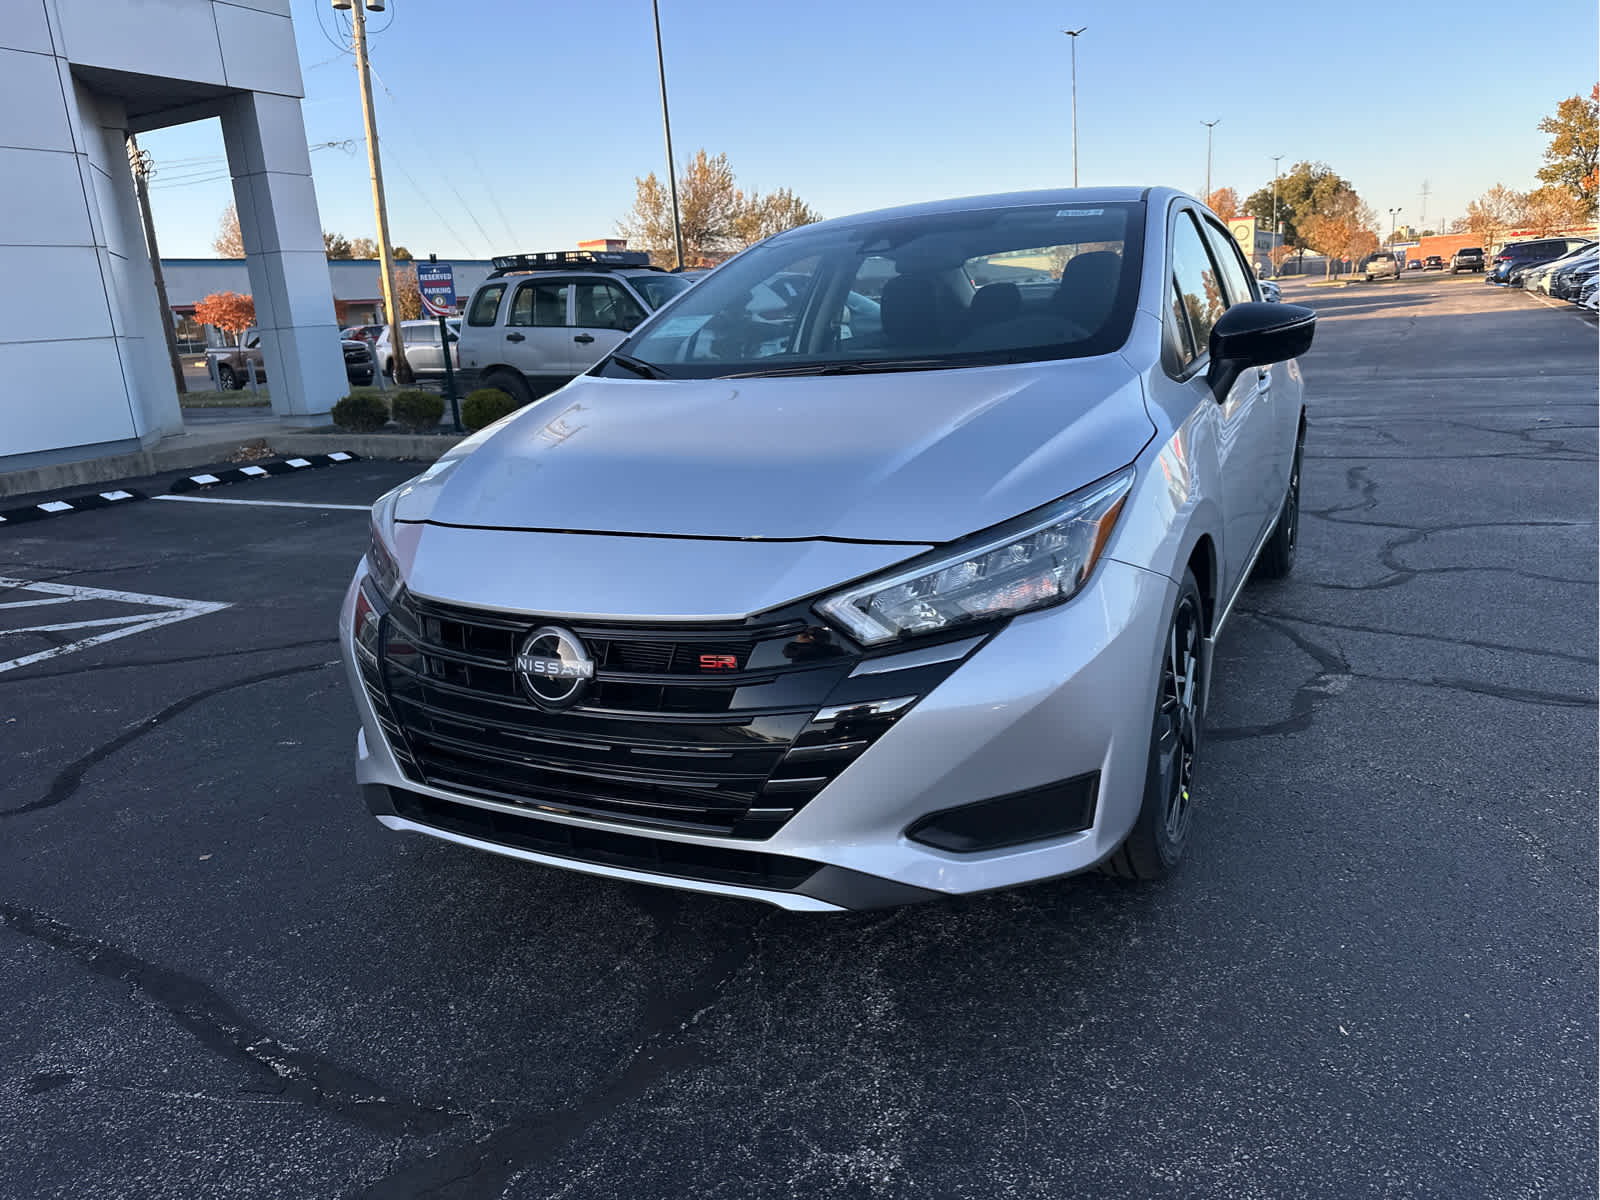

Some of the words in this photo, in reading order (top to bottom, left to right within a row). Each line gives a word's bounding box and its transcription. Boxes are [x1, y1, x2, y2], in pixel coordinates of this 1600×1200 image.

[420, 273, 452, 281] RESERVED
[424, 287, 452, 295] PARKING
[517, 656, 592, 676] NISSAN
[699, 654, 737, 669] SR
